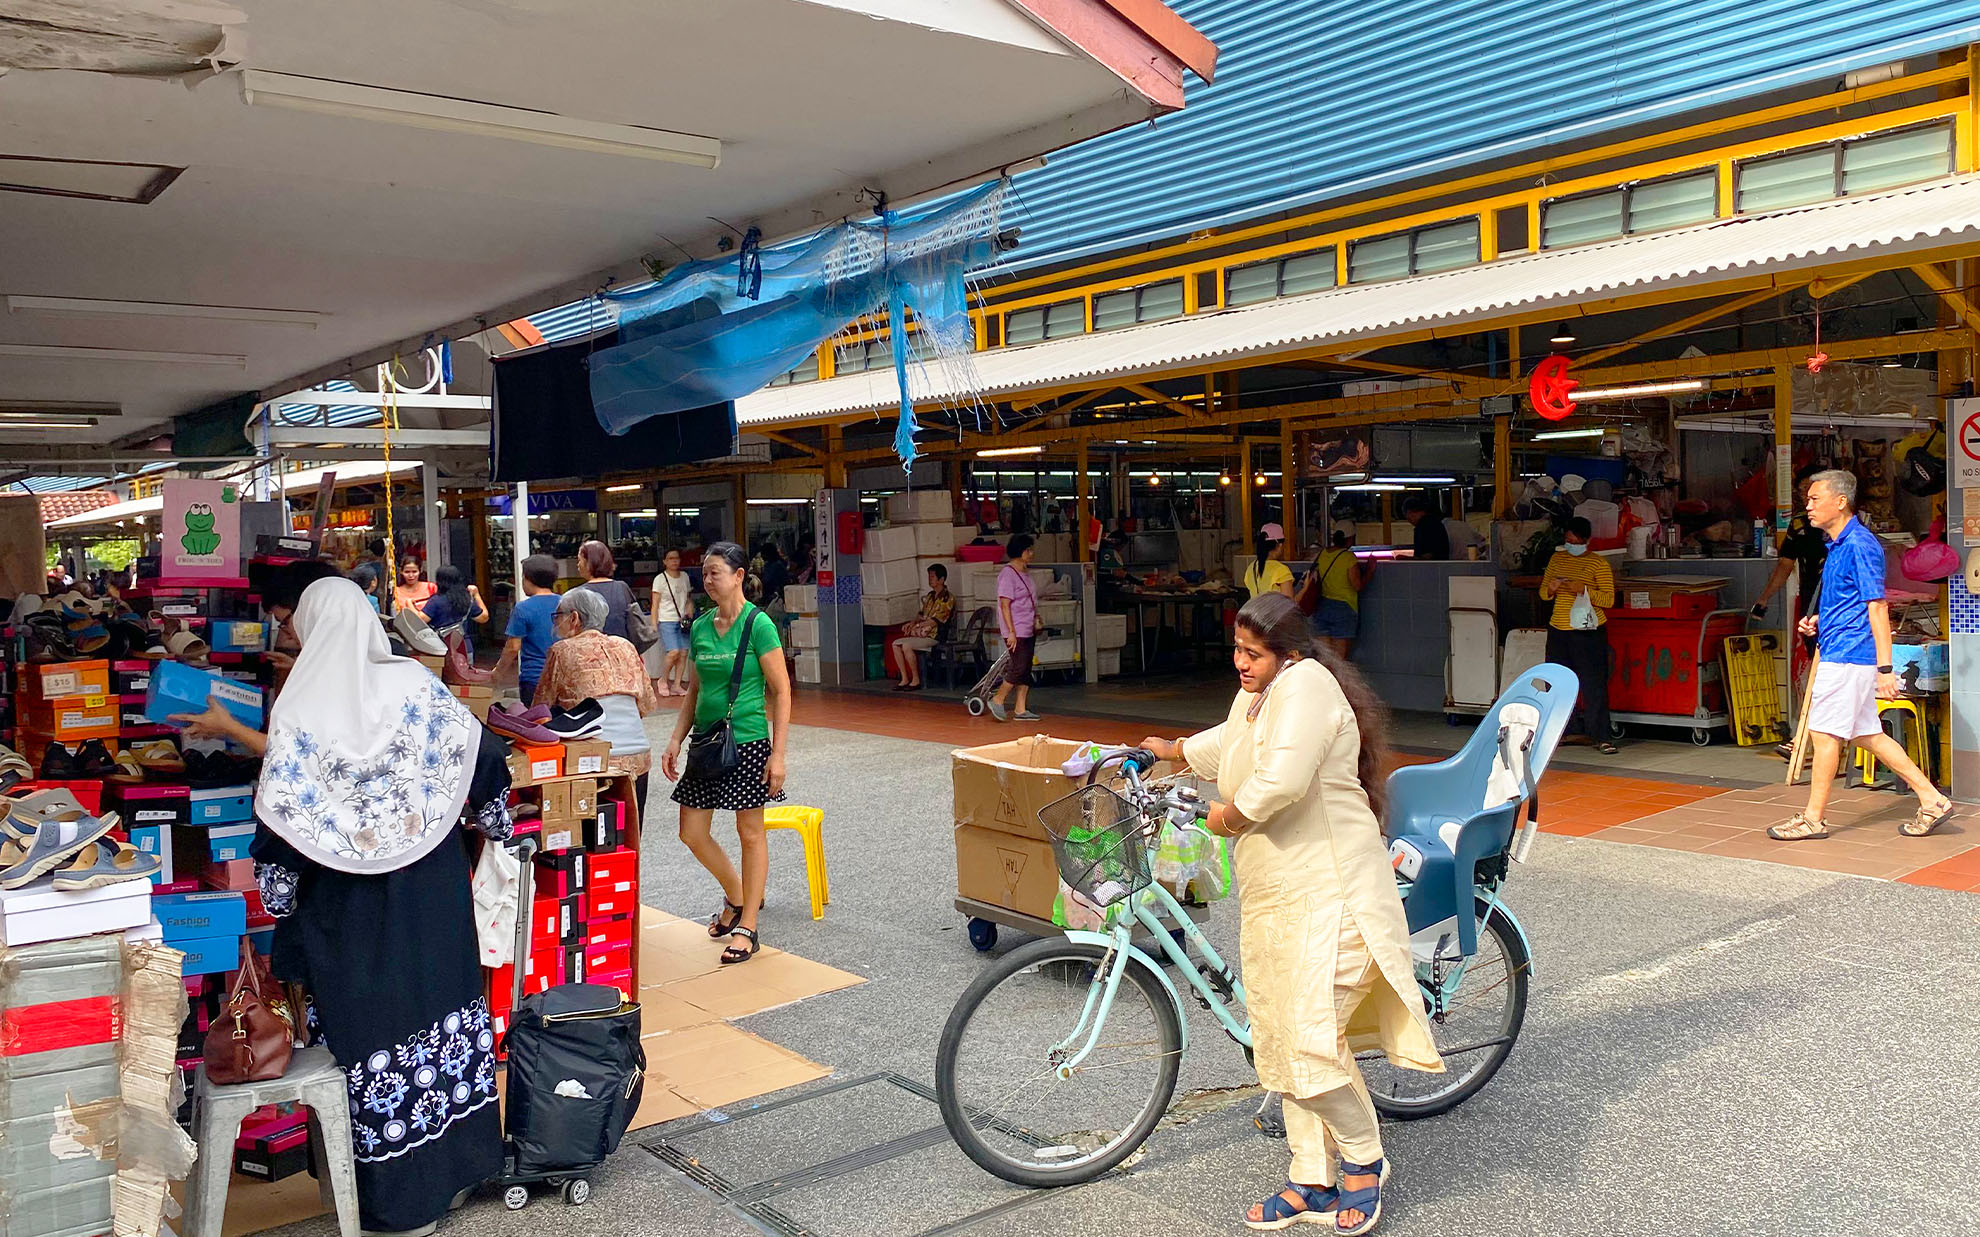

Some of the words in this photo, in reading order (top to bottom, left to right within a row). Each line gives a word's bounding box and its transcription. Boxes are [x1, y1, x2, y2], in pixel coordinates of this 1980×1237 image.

[1962, 468, 1973, 477] NO
[530, 495, 574, 508] VIVA
[219, 685, 257, 702] Fashion
[166, 916, 210, 927] Fashion
